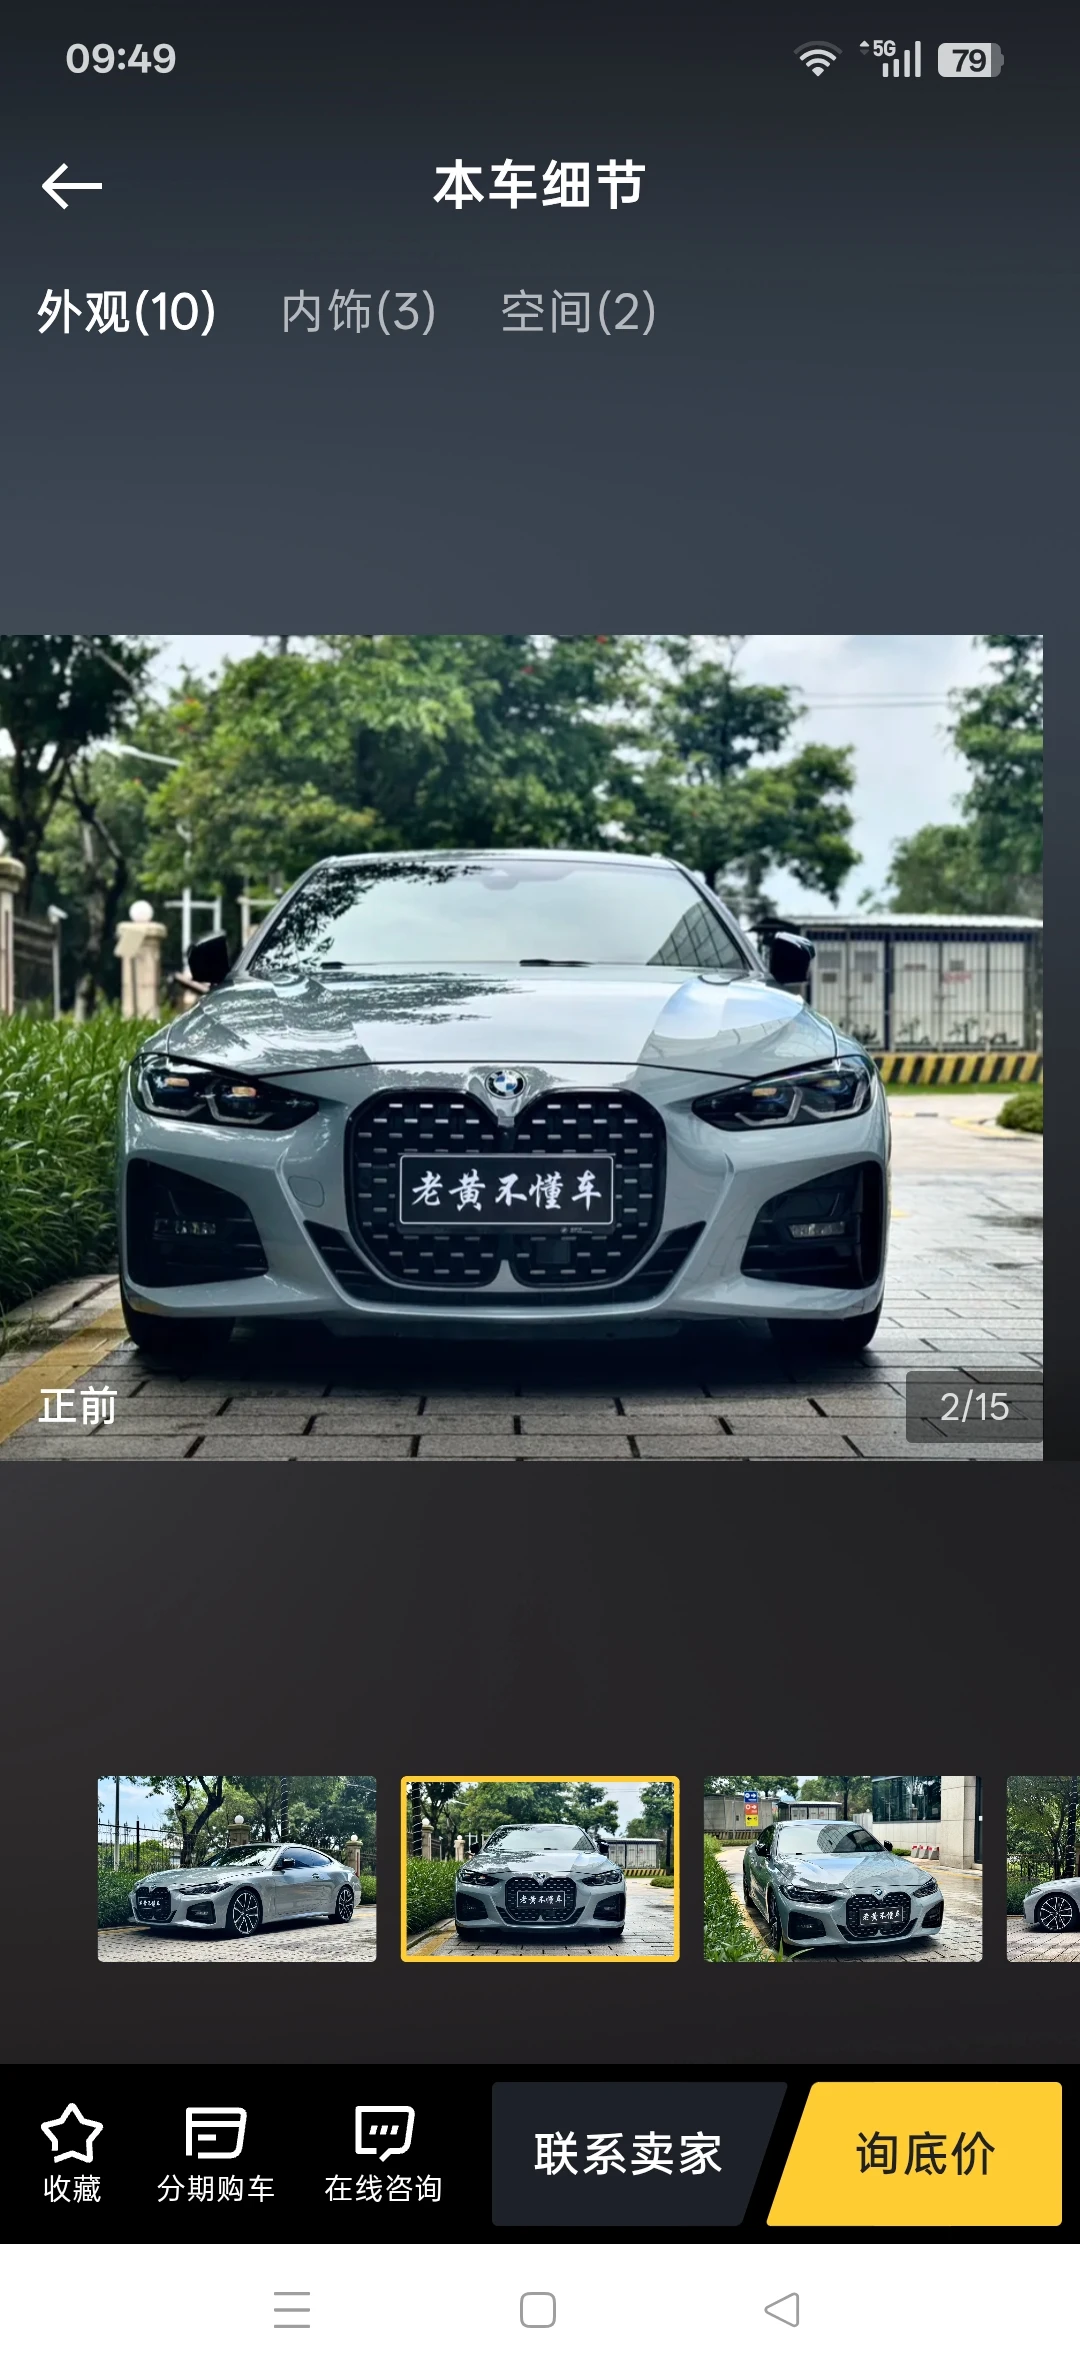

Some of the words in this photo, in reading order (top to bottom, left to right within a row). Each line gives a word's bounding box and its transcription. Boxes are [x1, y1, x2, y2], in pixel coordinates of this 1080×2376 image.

[66, 43, 176, 74] 09:49
[872, 40, 897, 58] 5G
[952, 48, 987, 73] 79
[432, 157, 646, 210] 本车细节
[36, 288, 215, 337] 外观(10)
[281, 288, 435, 336] 内饰(3)
[501, 288, 656, 336] 空间(2)
[412, 1168, 602, 1212] 老黄不懂车
[533, 2130, 723, 2176] 联系卖家
[856, 2130, 996, 2176] 询底价
[43, 2173, 102, 2204] 收藏
[156, 2173, 275, 2203] 分期购车
[324, 2173, 442, 2203] 在线咨询
